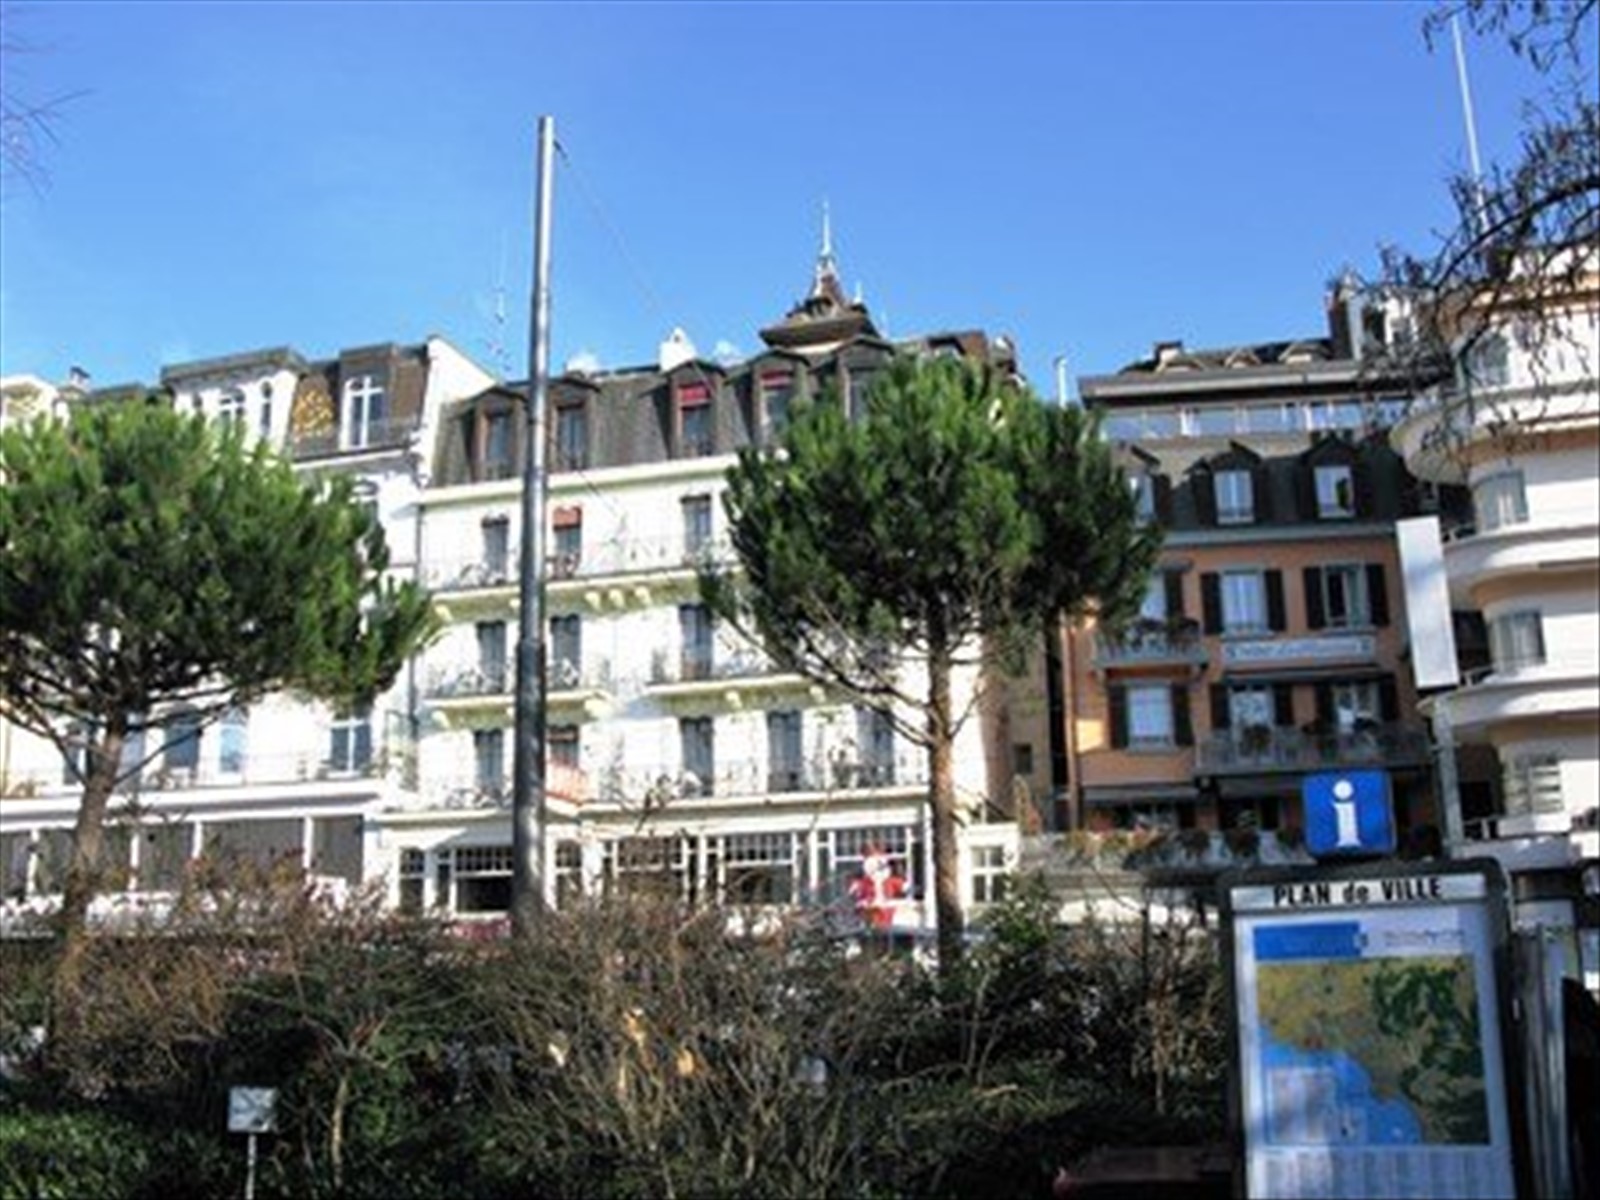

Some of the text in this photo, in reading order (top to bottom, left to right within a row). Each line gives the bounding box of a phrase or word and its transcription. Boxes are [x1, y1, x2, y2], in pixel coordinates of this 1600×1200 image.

[1333, 779, 1361, 847] i
[1274, 877, 1442, 906] PLAN de VILLE
